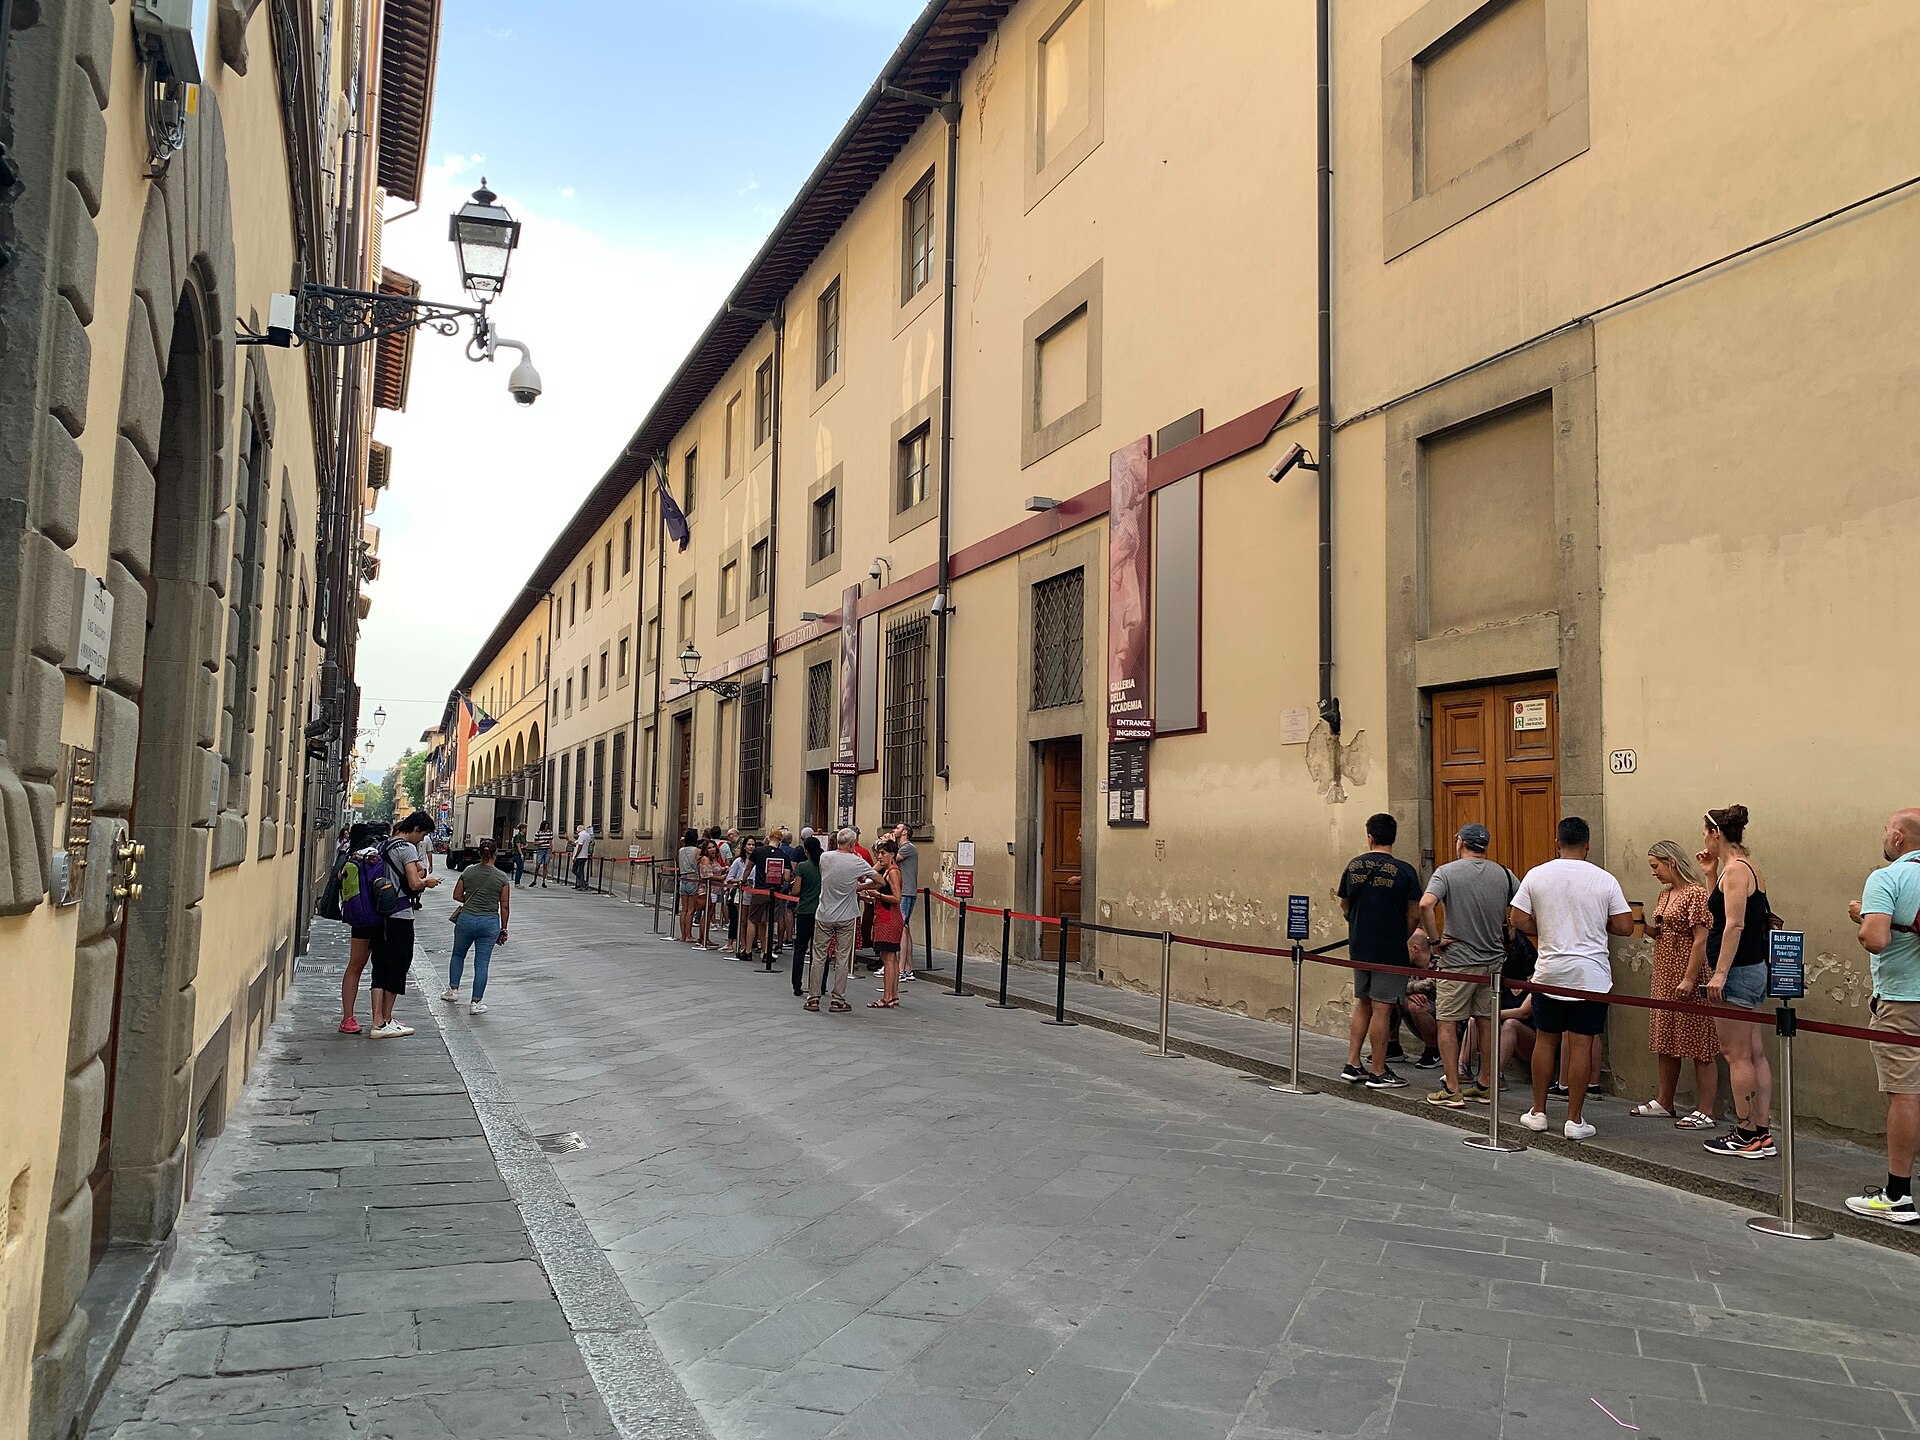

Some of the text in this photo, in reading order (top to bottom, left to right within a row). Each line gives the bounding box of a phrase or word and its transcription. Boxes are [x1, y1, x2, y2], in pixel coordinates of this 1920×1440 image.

[776, 622, 819, 653] LIMITED EDITION
[1110, 678, 1135, 692] GALLERIA
[1110, 691, 1126, 703] DELLA
[1110, 700, 1142, 713] ACCADEMIA
[1116, 719, 1151, 727] ENTRANCE
[1116, 729, 1151, 737] INGRESSO
[1614, 752, 1633, 770] 56
